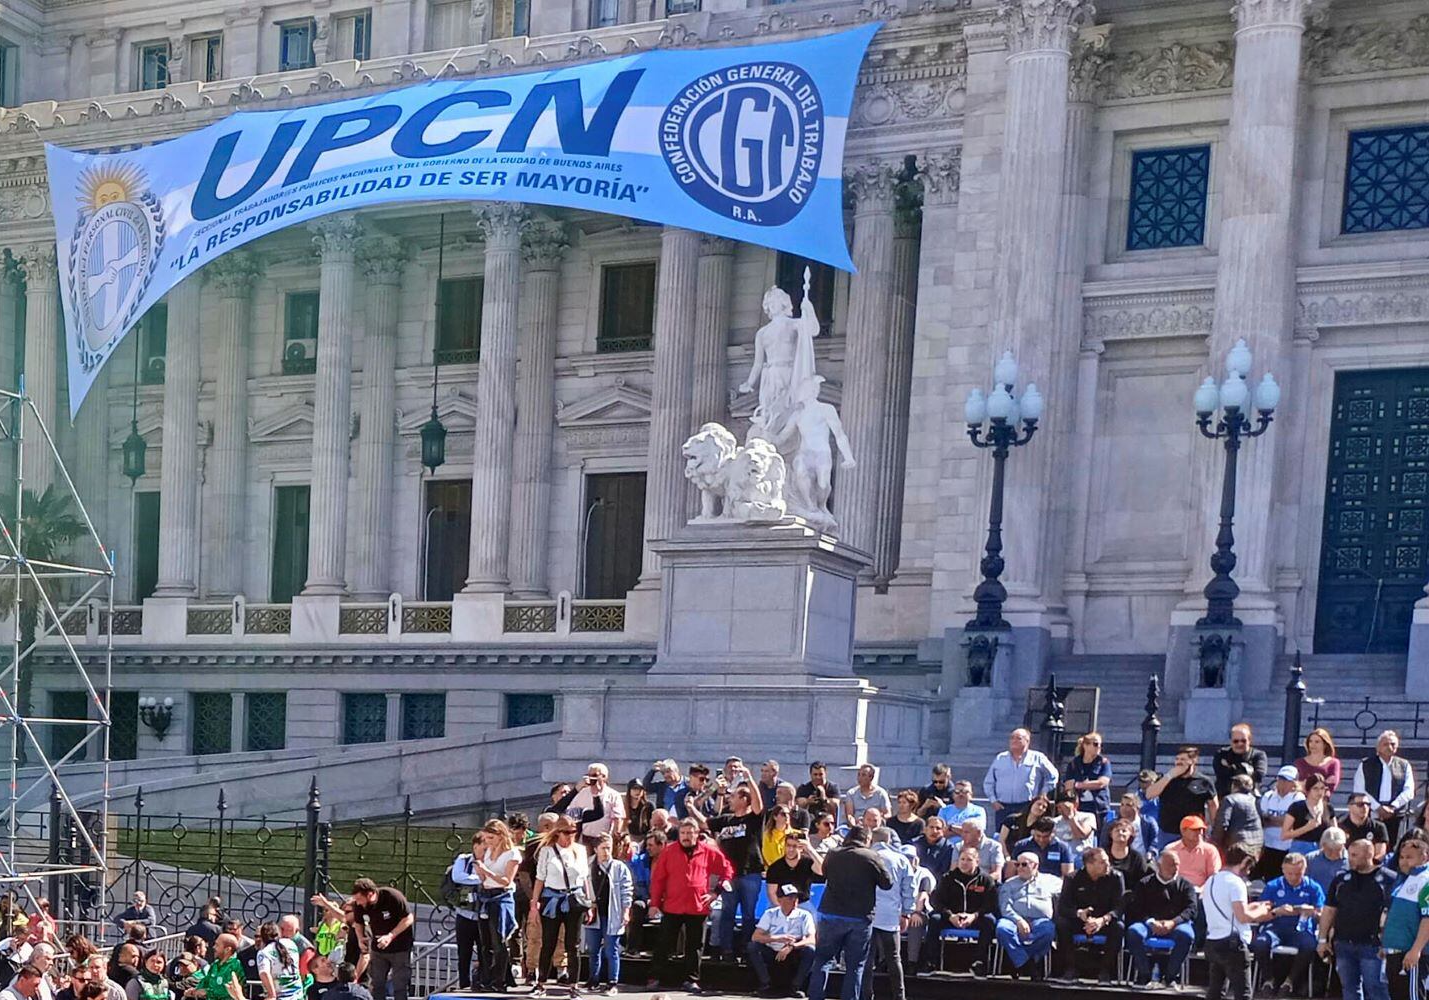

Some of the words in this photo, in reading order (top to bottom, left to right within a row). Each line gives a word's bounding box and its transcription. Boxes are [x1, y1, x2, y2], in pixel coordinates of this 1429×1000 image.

[727, 65, 800, 91] GENERAL
[795, 84, 818, 118] DEL
[190, 68, 646, 221] UPCN
[340, 164, 394, 180] NACIONALES
[404, 161, 420, 169] DEL
[423, 157, 469, 167] GOBIERNO
[472, 157, 484, 165] DE
[500, 157, 536, 165] CIUDAD
[539, 158, 551, 166] DE
[553, 159, 592, 169] BUENOS
[595, 162, 623, 173] AIRES
[664, 73, 722, 185] CONFEDERACIÓN
[689, 87, 795, 198] CGT
[789, 120, 820, 204] TRABAJO
[206, 173, 412, 252] RESPONSABILIDAD
[420, 171, 453, 187] DE
[459, 171, 508, 187] SER
[732, 205, 762, 222] R.A.
